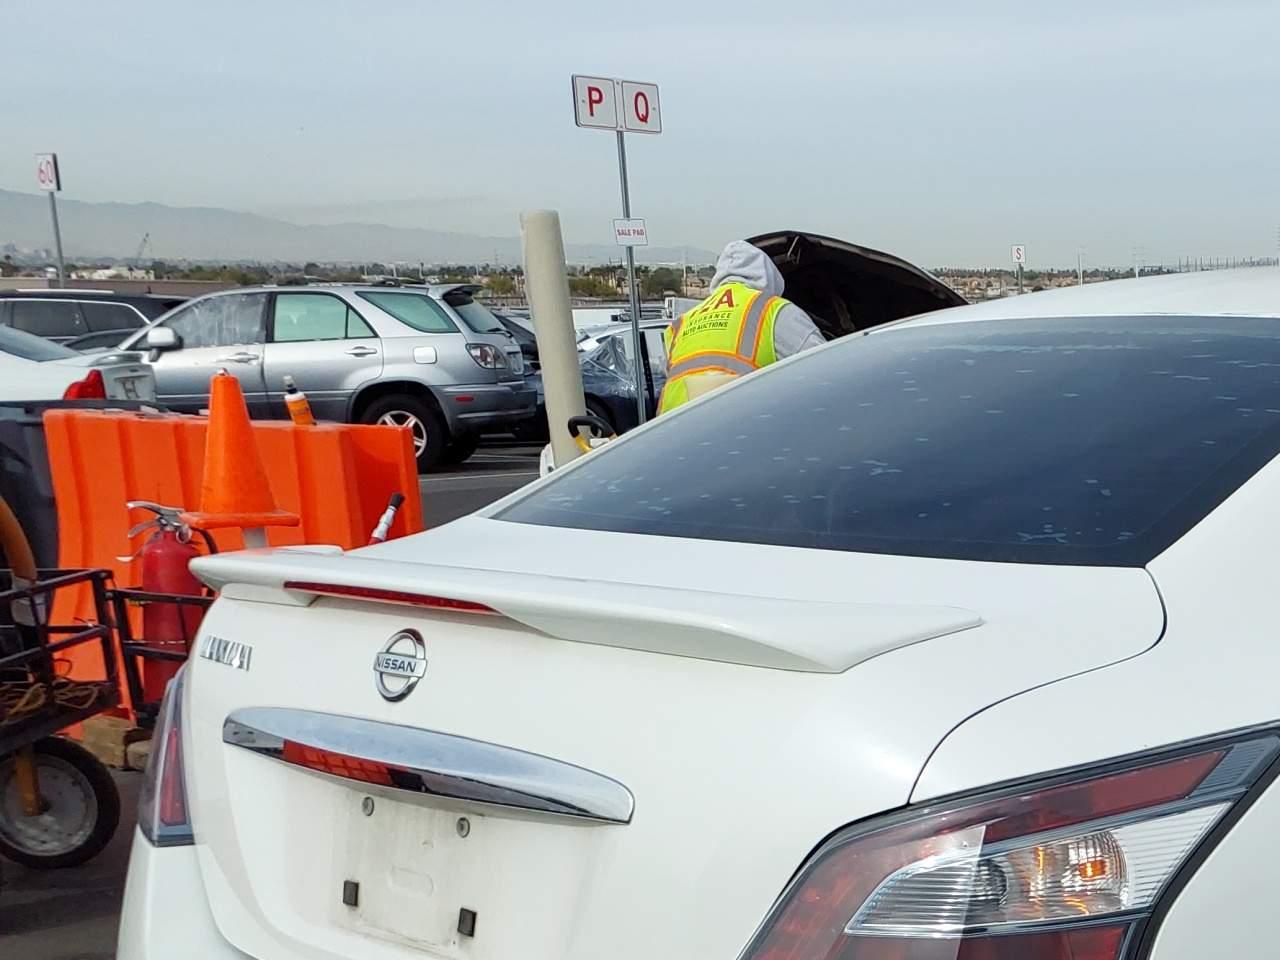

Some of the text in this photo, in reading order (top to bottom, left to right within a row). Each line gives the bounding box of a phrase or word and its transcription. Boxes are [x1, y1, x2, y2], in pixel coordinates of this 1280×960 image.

[587, 86, 603, 117] P
[634, 91, 649, 124] Q
[1015, 247, 1021, 260] S
[697, 321, 729, 330] AUCTIONS
[376, 655, 417, 673] NISSAN
